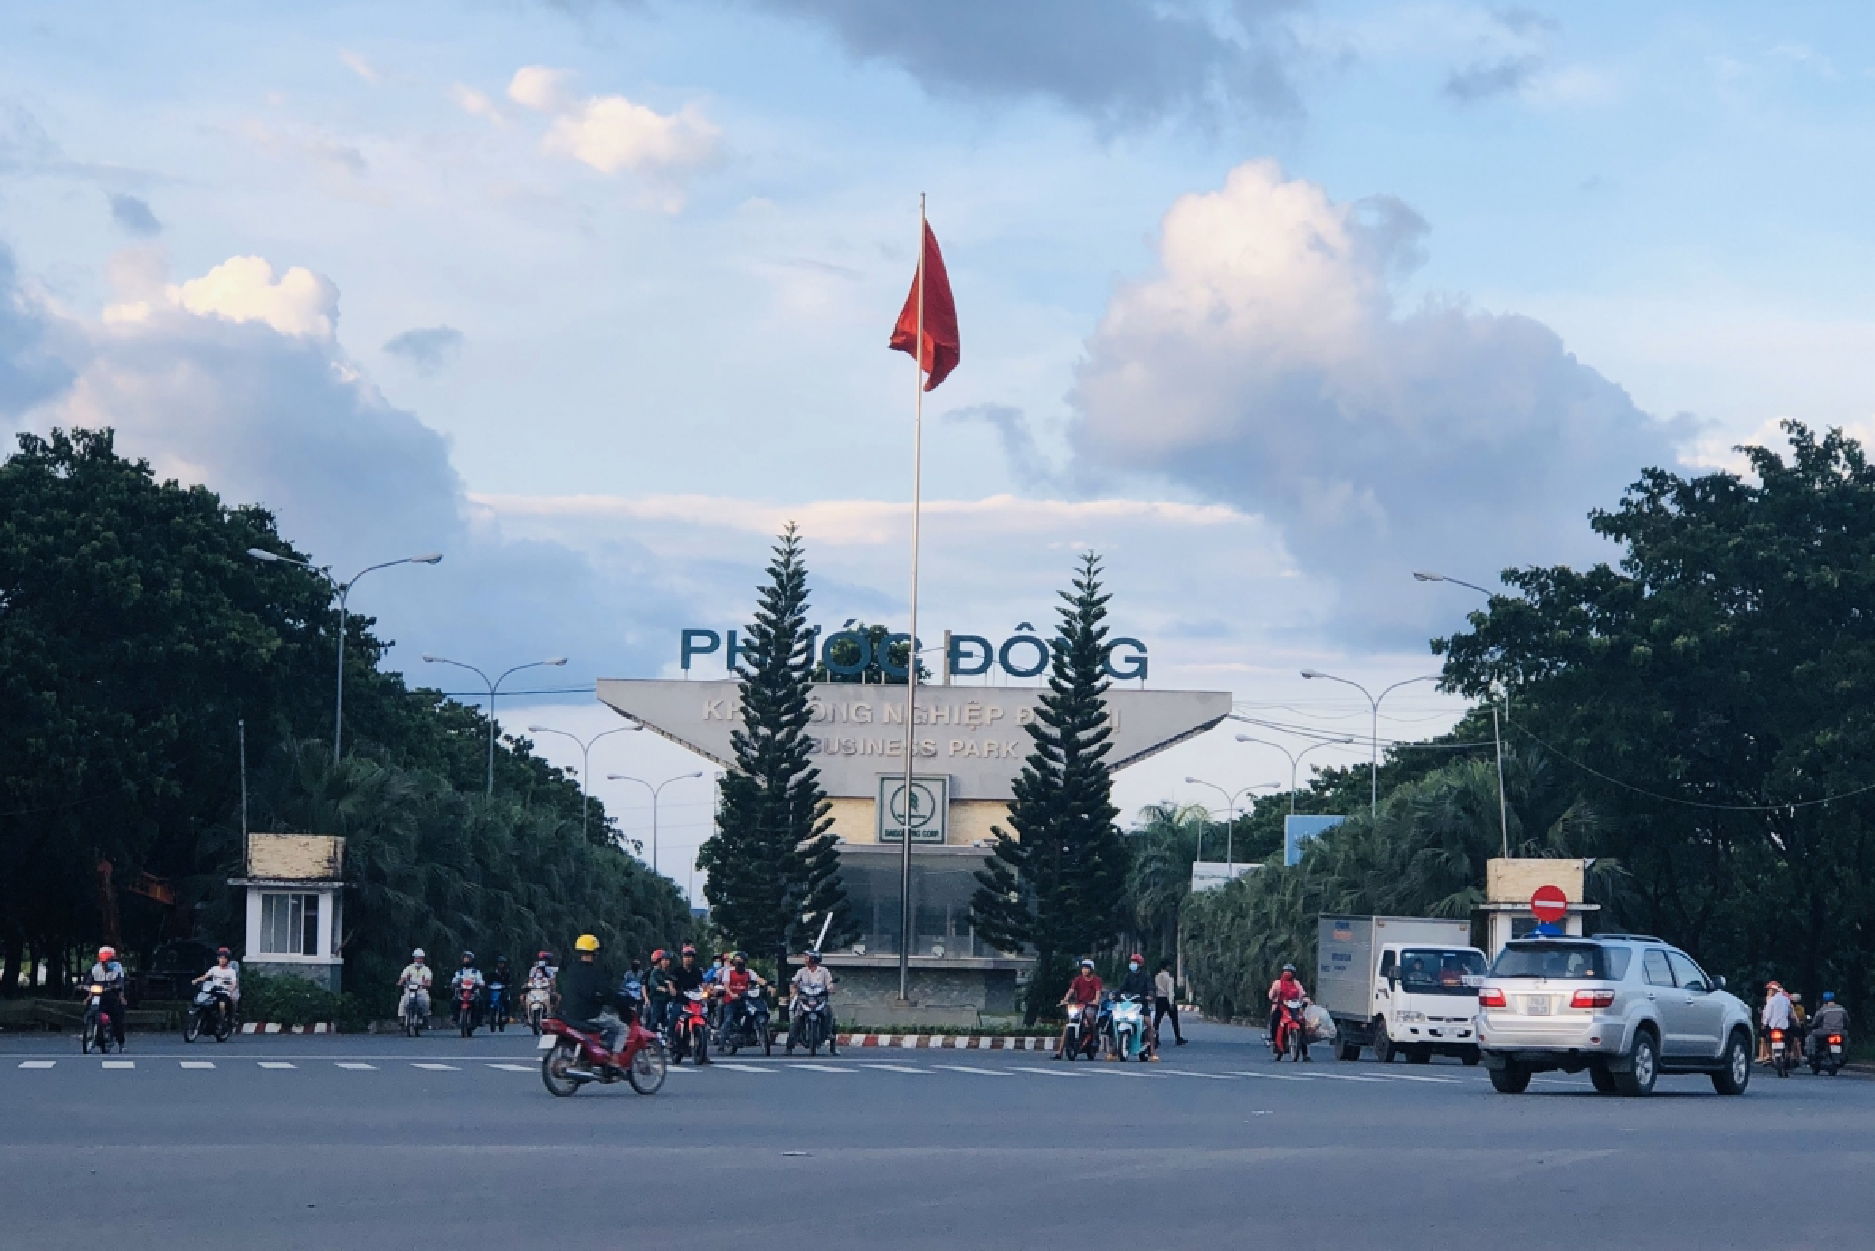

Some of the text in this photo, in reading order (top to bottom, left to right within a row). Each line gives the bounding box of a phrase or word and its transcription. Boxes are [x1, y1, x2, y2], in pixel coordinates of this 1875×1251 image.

[947, 622, 1148, 680] ĐÔG
[799, 696, 873, 725] ÔNG
[883, 700, 1005, 731] NGHIỆP
[949, 740, 1019, 760] PARK
